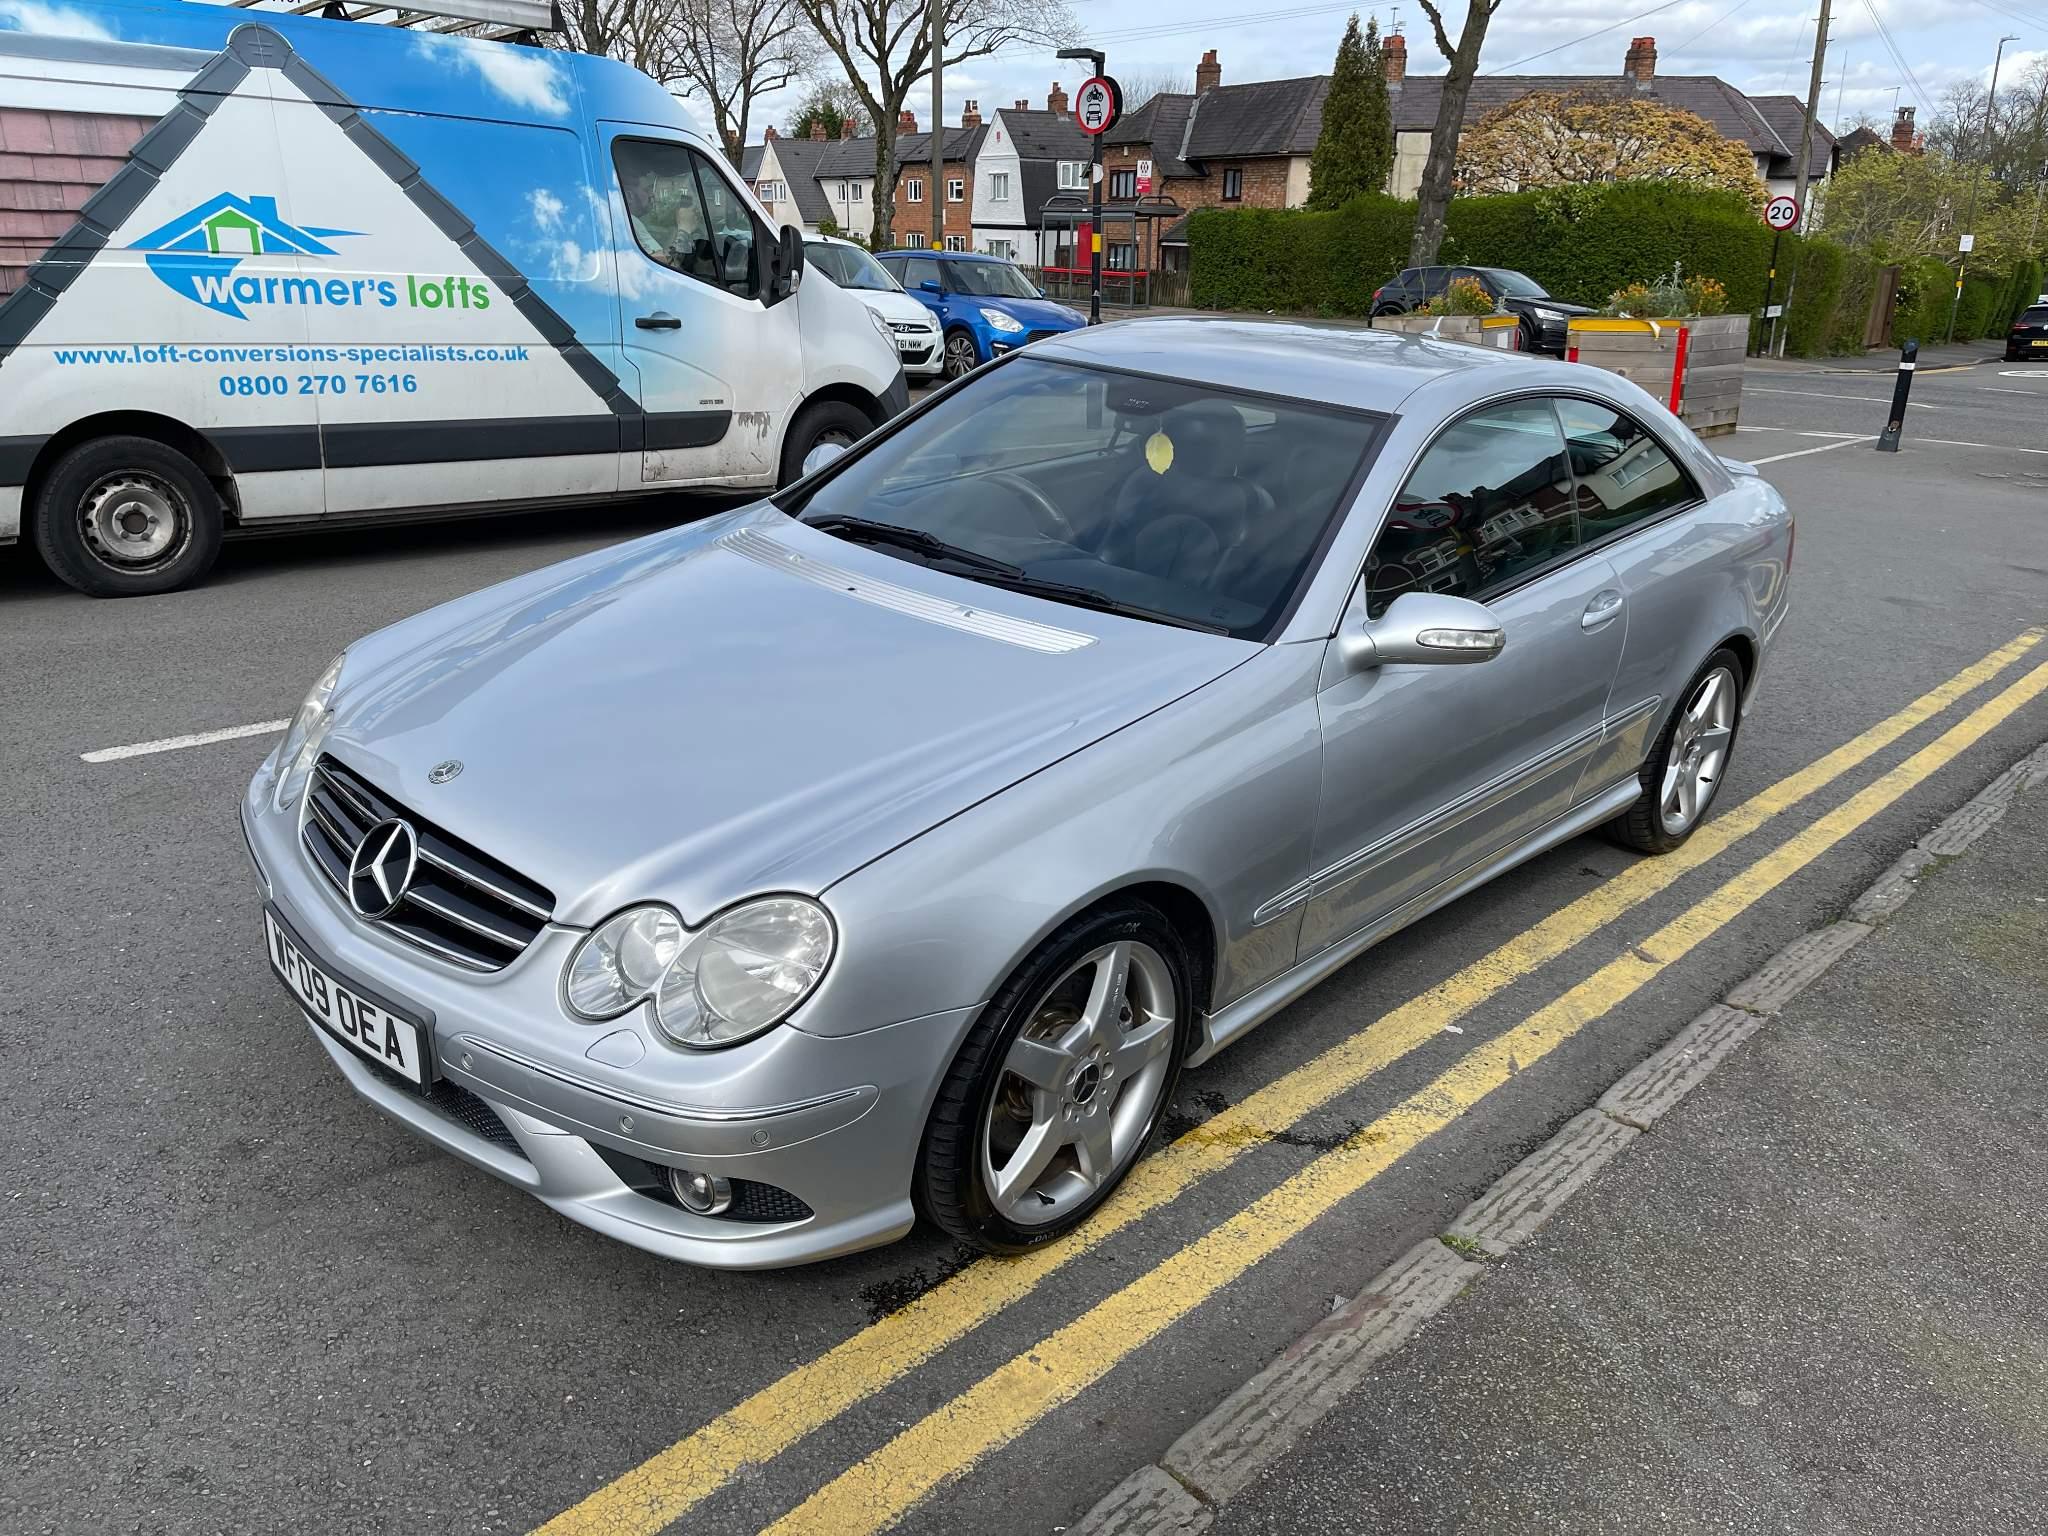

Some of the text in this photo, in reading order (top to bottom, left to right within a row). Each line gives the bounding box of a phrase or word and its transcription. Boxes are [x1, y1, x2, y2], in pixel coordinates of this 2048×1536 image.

[1770, 206, 1794, 220] 20
[407, 274, 490, 310] lofts
[53, 344, 530, 366] www.loft-conversions-specialists.co.uk
[219, 373, 418, 397] 0800 270 7616
[335, 987, 406, 1069] OEA
